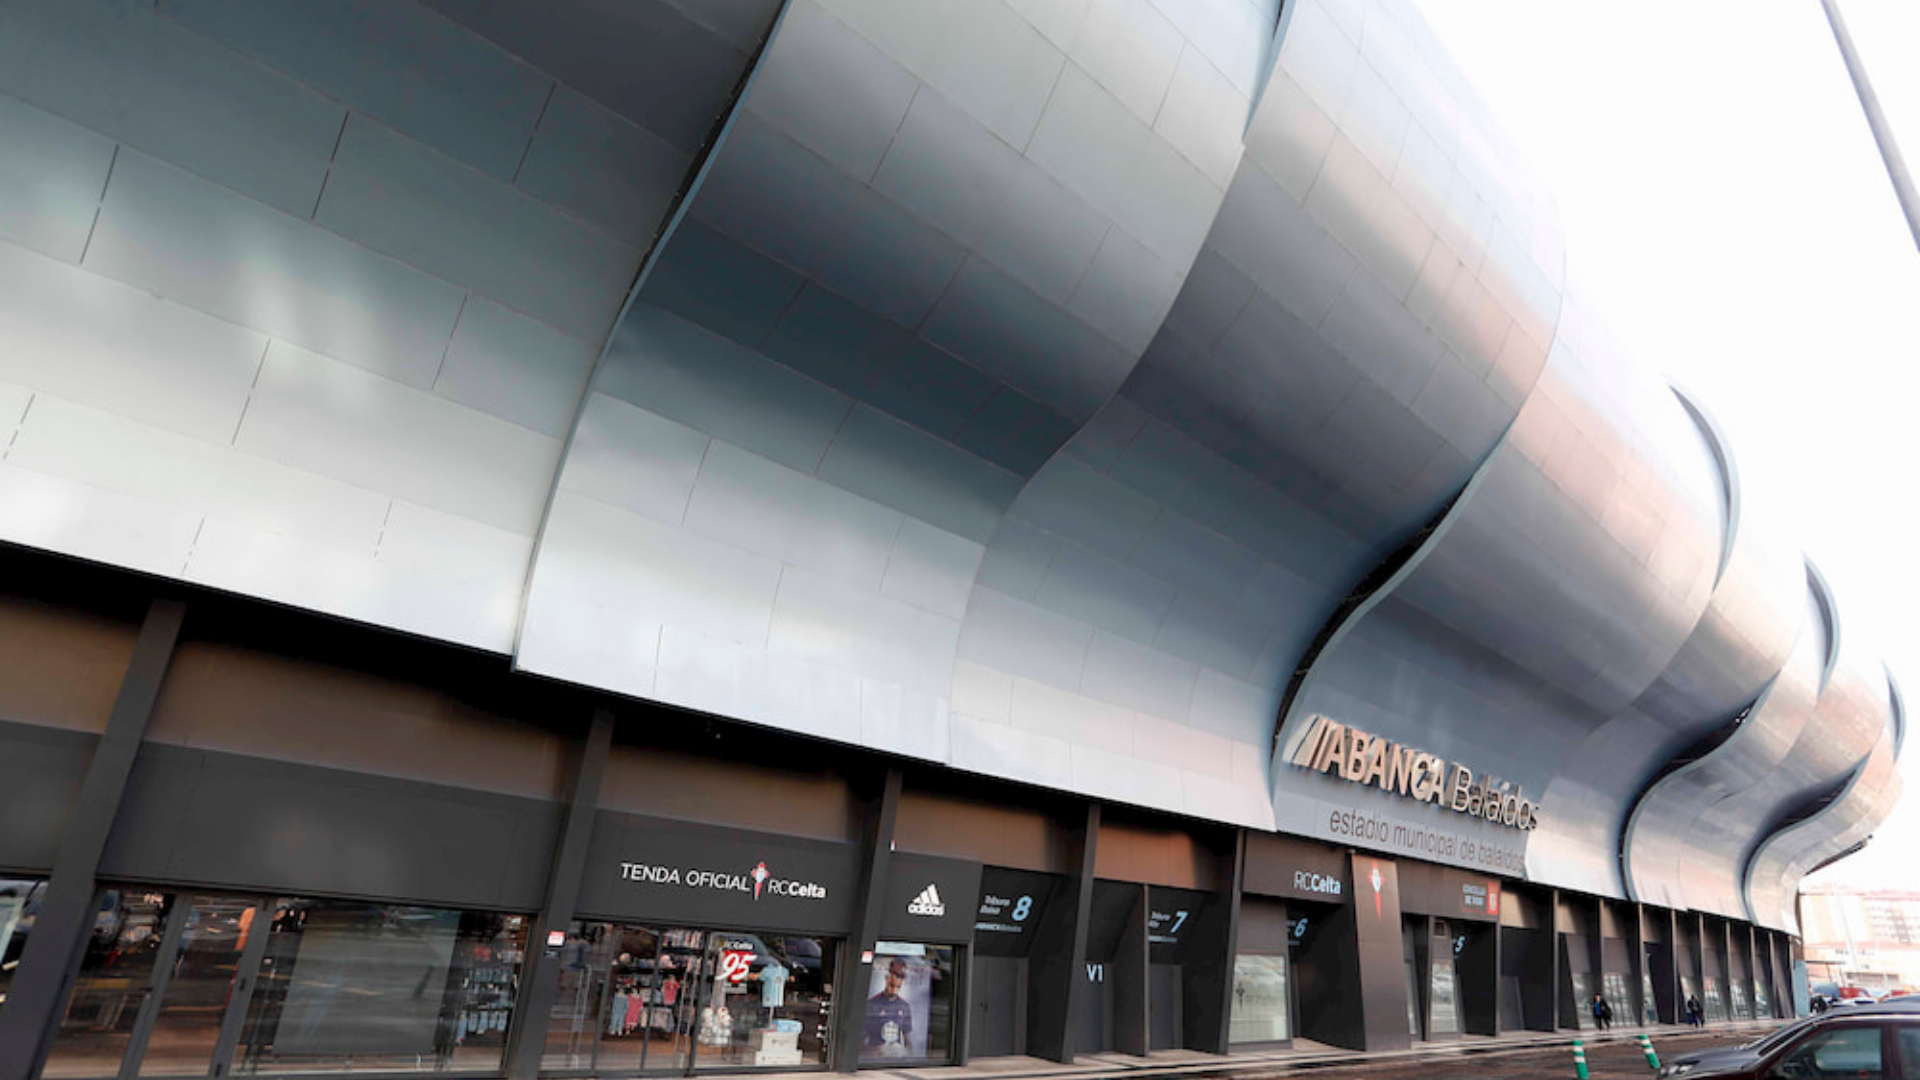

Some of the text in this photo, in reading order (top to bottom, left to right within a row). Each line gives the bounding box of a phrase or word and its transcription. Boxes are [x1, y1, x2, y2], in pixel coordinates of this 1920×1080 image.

[1308, 721, 1448, 808] ABANCA
[1330, 808, 1389, 843] estadio
[1393, 822, 1458, 860] municipal
[1460, 836, 1476, 862] de
[621, 862, 681, 885] TENDA
[685, 869, 751, 892] OFICIAL
[908, 902, 946, 916] adidas
[1011, 895, 1034, 922] 8
[1170, 910, 1190, 934] 7
[1294, 917, 1309, 939] 6
[1454, 935, 1466, 953] 5
[715, 952, 758, 981] 95
[1086, 963, 1104, 982] V1
